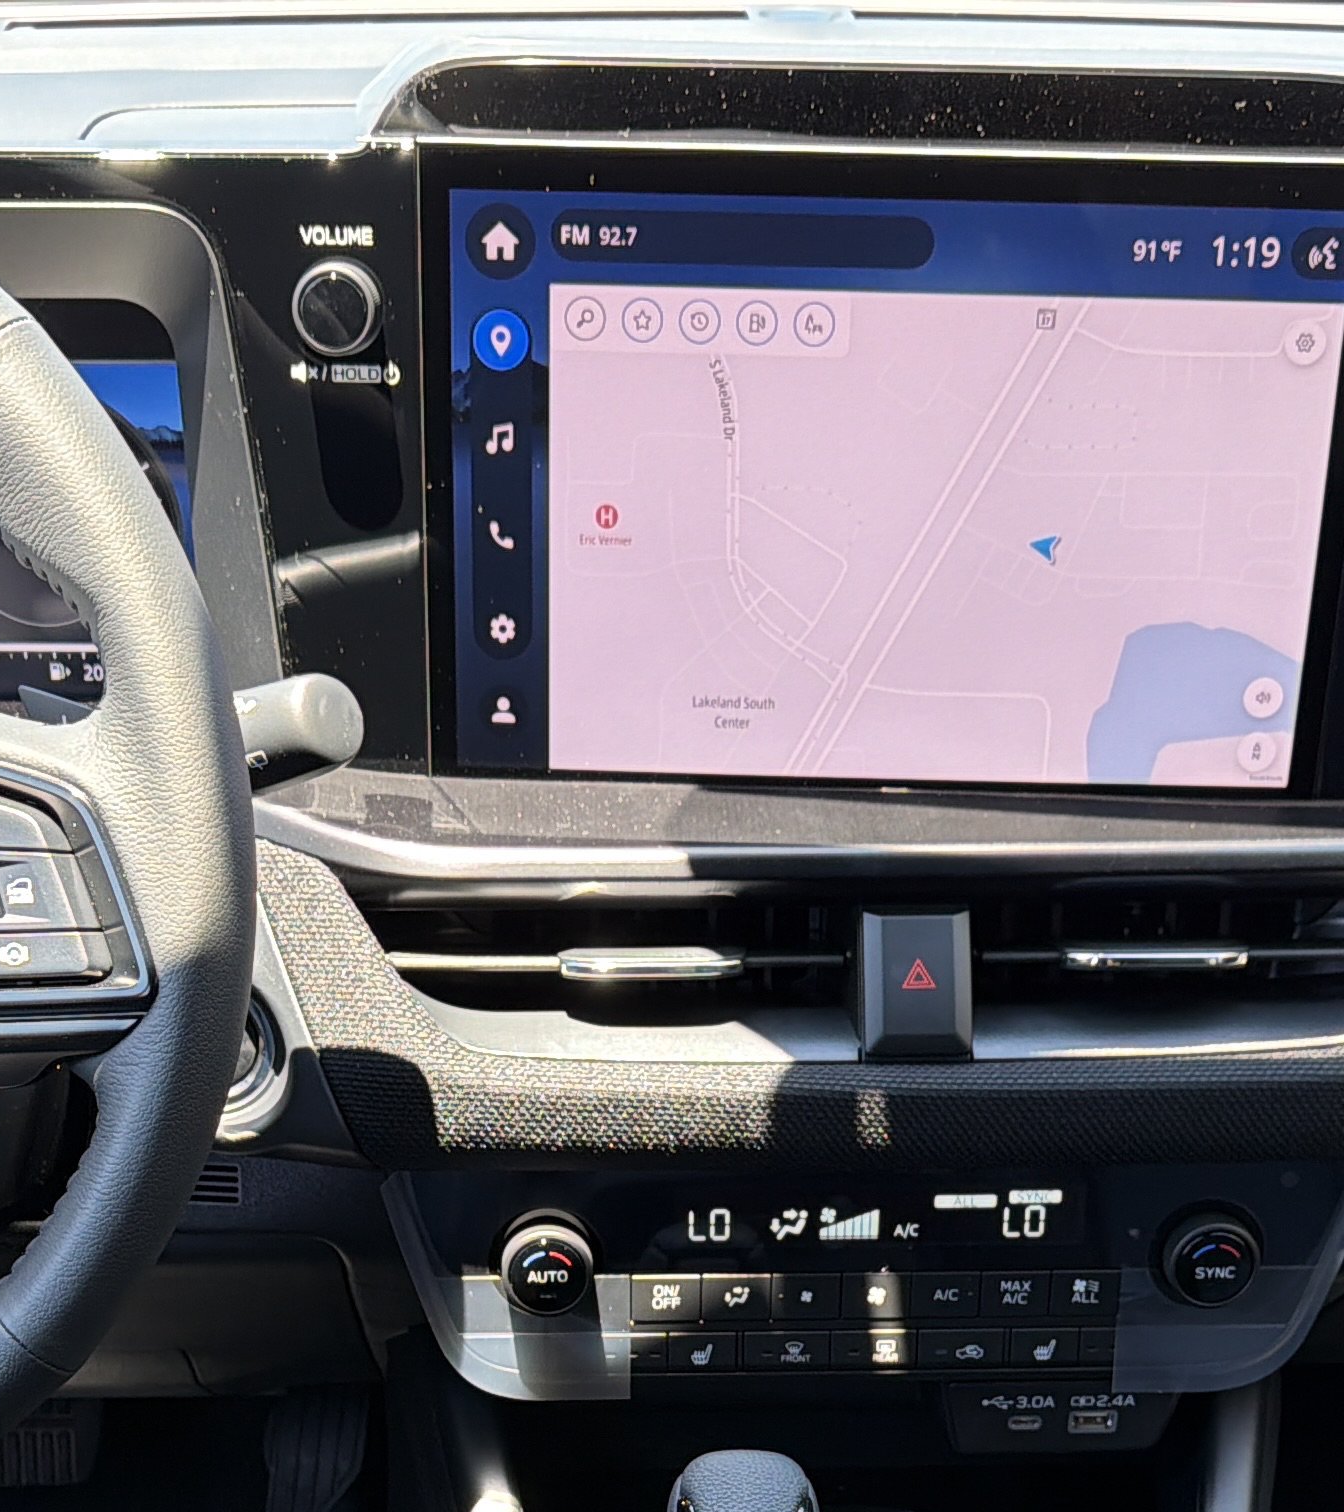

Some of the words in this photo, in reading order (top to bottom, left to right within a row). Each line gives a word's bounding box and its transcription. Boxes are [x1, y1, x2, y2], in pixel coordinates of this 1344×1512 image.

[299, 224, 374, 246] VOLUME
[560, 225, 590, 246] FM
[599, 225, 638, 247] 92.7
[1132, 238, 1182, 263] 91°F
[1212, 235, 1281, 269] 1:19
[333, 366, 380, 381] HOLD
[712, 369, 736, 426] Lakeland
[723, 426, 736, 442] Dr
[579, 533, 596, 546] Eric
[692, 695, 741, 711] Lakeland
[743, 696, 775, 711] South
[714, 715, 750, 730] Center
[688, 1208, 731, 1242] LO
[1002, 1204, 1046, 1238] LO
[894, 1223, 920, 1239] A/C
[526, 1269, 569, 1284] AUTO
[1194, 1266, 1237, 1280] SYNC
[652, 1284, 681, 1299] ON/
[1000, 1280, 1032, 1293] MAX
[933, 1287, 959, 1302] A/C
[1002, 1292, 1028, 1305] A/C
[1071, 1292, 1100, 1305] ALL
[651, 1296, 682, 1311] OFF
[780, 1353, 811, 1364] FRONT
[1015, 1395, 1055, 1409] 3.0A
[1095, 1394, 1136, 1408] 2.4A
